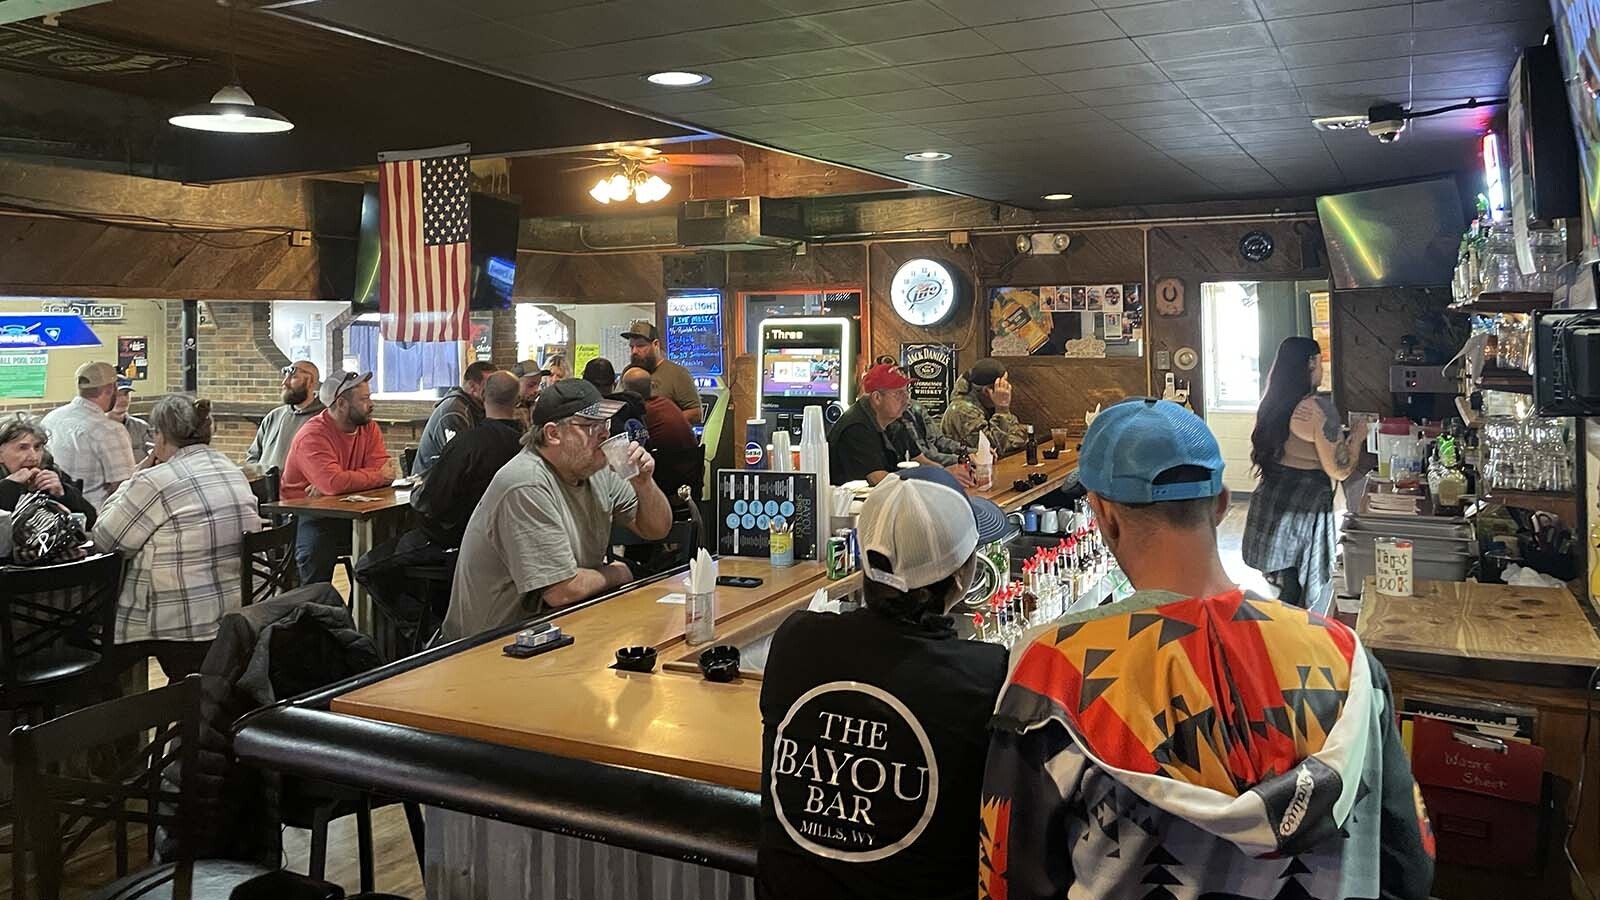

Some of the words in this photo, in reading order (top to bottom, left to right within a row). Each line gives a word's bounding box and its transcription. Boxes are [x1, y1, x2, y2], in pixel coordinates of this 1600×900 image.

[82, 306, 120, 317] LIGHT
[771, 329, 803, 340] Three
[907, 350, 924, 365] JACK
[923, 347, 951, 366] DANIEL'S
[694, 378, 712, 387] ATM
[802, 498, 812, 535] BAYOU
[818, 711, 888, 751] THE
[776, 738, 929, 801] BAYOU
[803, 785, 876, 826] BAR
[799, 820, 847, 843] MILLS,
[851, 830, 876, 846] WY
